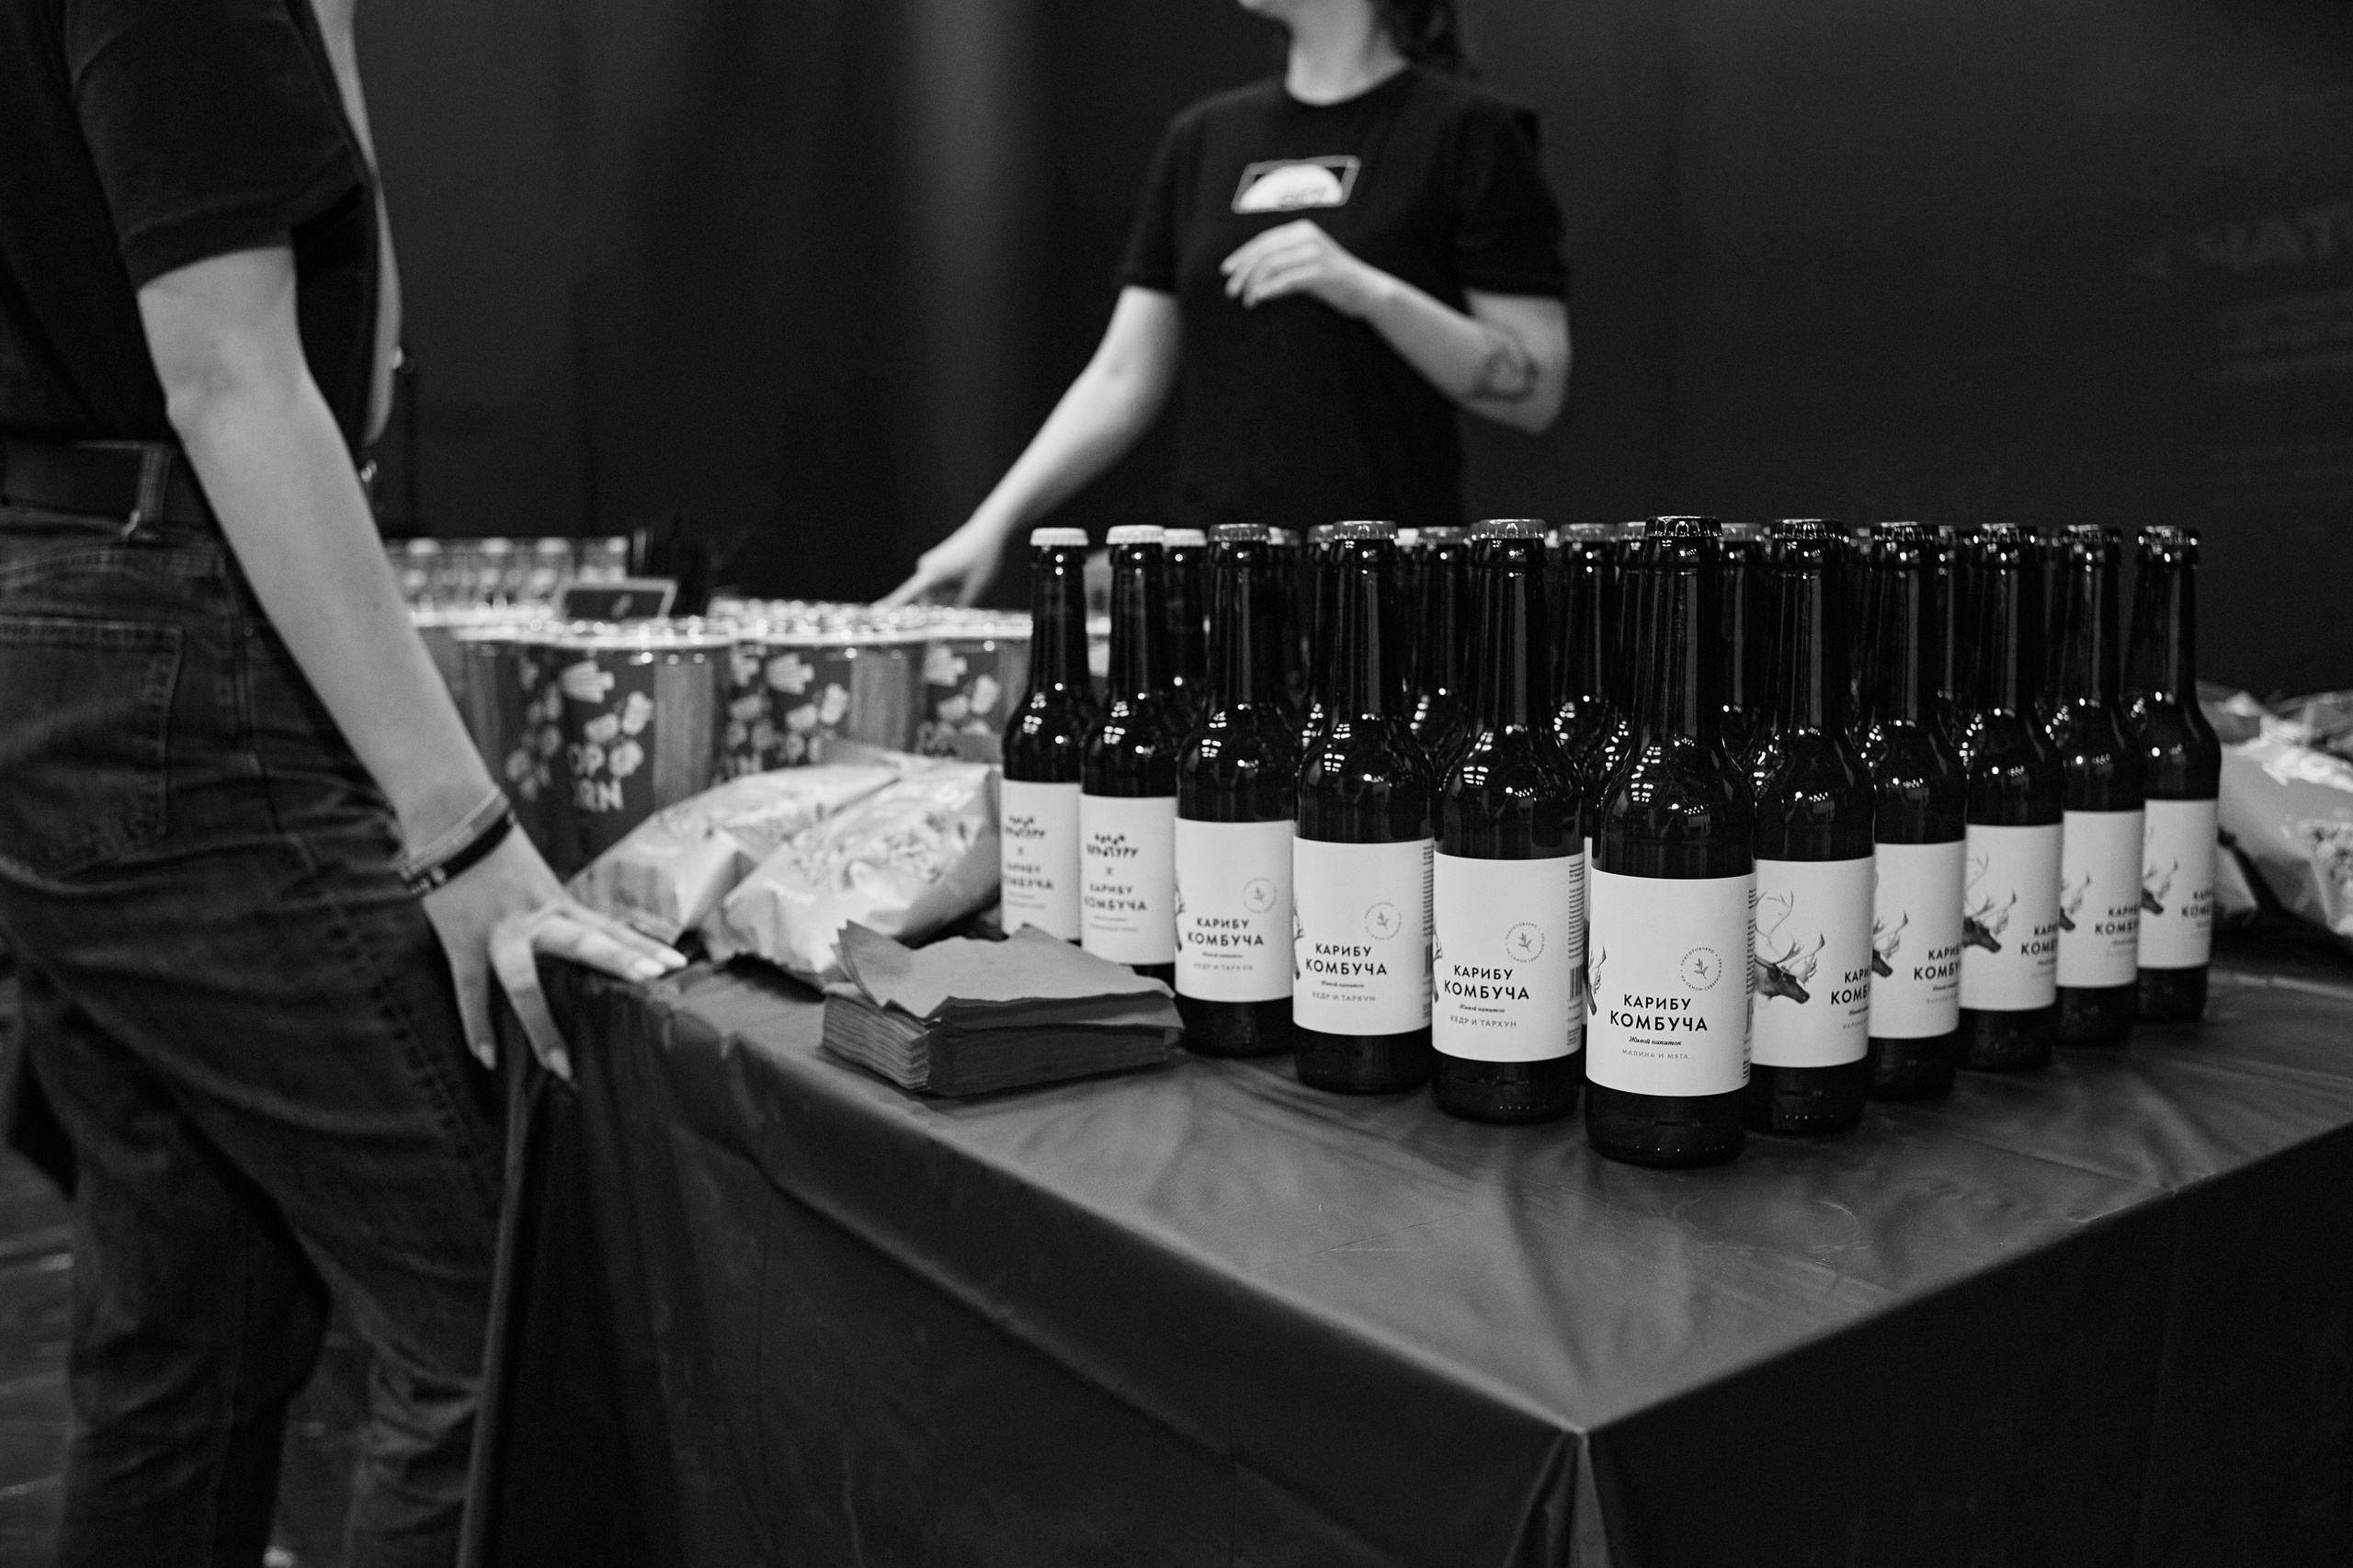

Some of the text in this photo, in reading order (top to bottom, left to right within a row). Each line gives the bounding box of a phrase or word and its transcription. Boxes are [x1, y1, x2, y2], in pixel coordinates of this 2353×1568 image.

[1196, 917, 1249, 929] КАРИБУ
[1188, 931, 1264, 947] КОМБУЧА
[1315, 943, 1372, 958] КАРИБУ
[1305, 958, 1388, 976] КОМБУЧА
[1454, 964, 1513, 981] КАРИБУ
[1444, 980, 1529, 1000] КОМБУЧА
[1623, 994, 1691, 1011] КАРИБУ
[1450, 1015, 1517, 1028] КЕДР И ТАРХУН
[1610, 1010, 1708, 1032] КОМБУЧА
[1629, 1036, 1651, 1045] Живой
[1621, 1049, 1655, 1059] МАЛИНА
